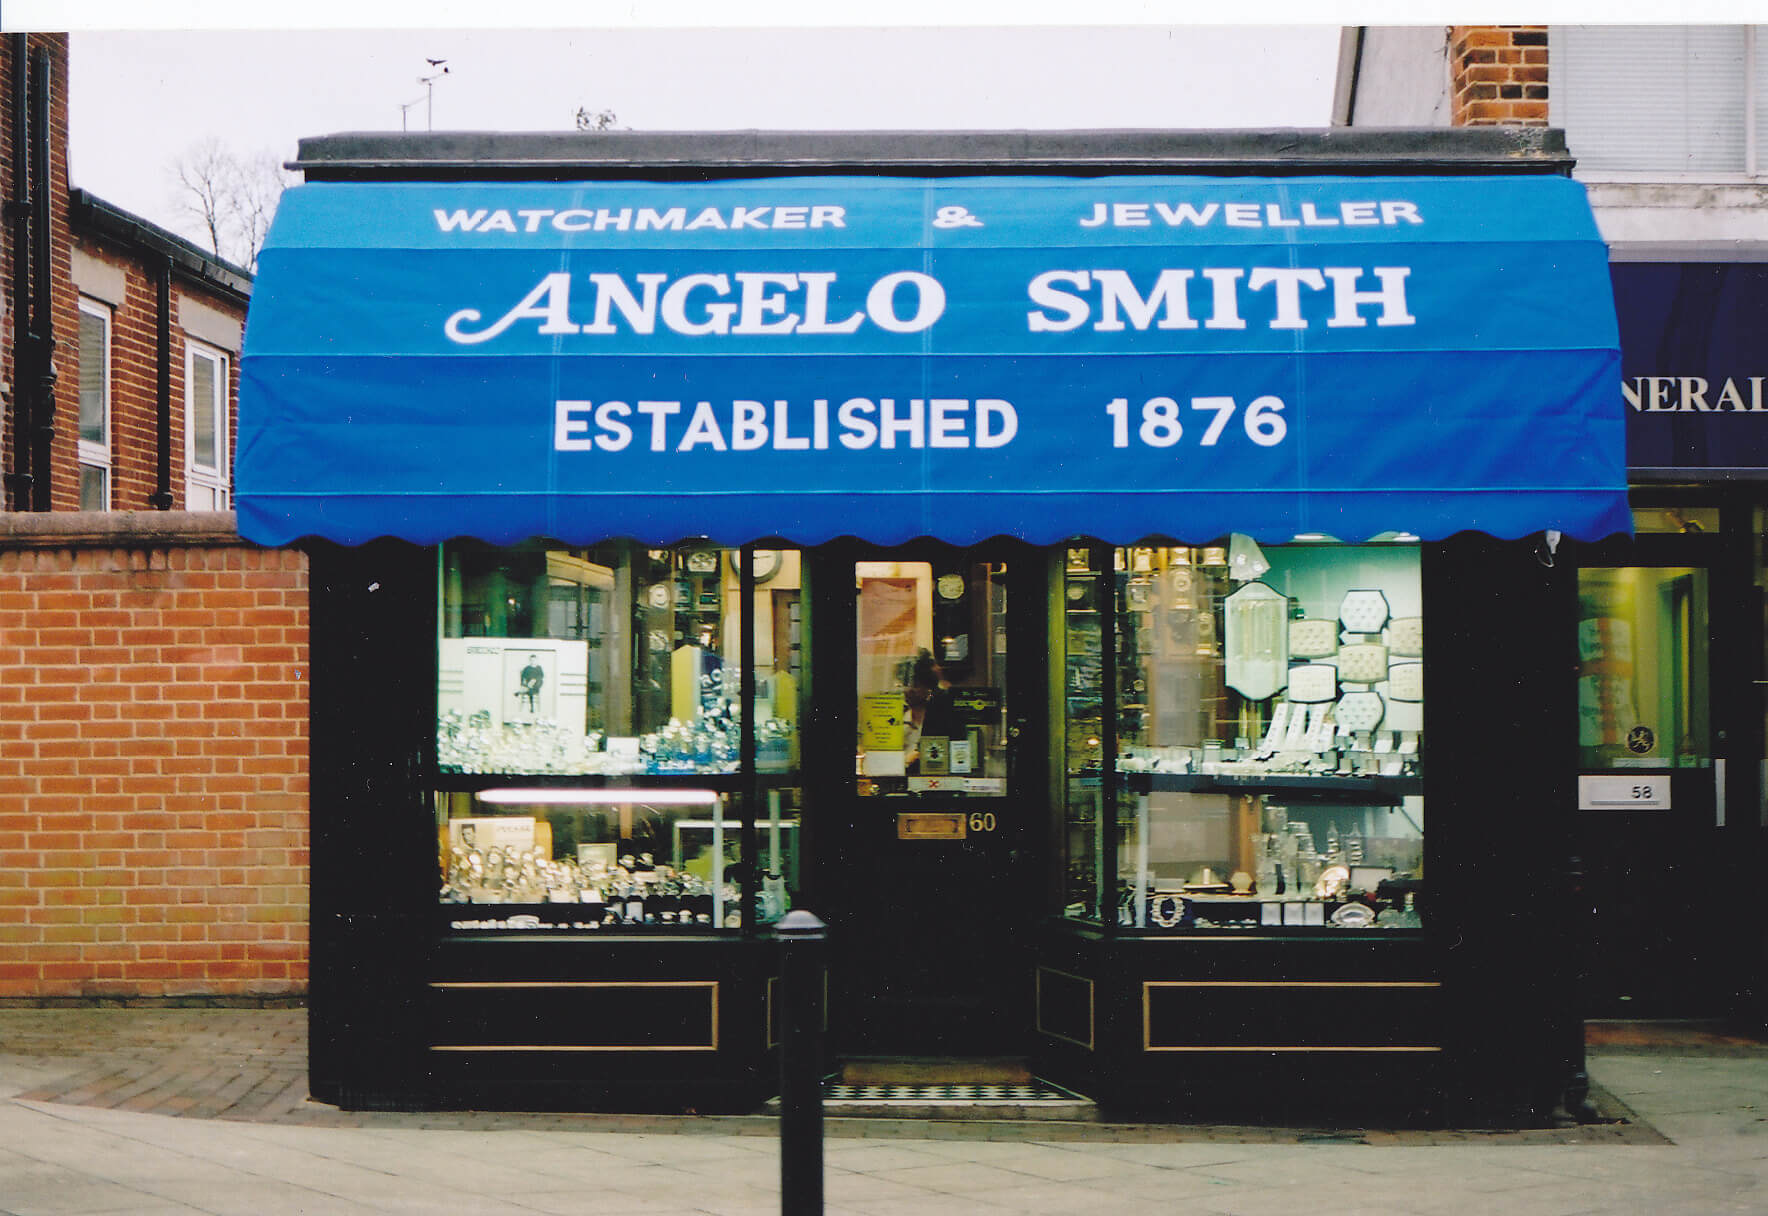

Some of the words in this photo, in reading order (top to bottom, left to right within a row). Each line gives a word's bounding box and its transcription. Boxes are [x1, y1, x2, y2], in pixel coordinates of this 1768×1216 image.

[434, 205, 846, 234] WATCHMAKER
[932, 205, 984, 229] &
[1078, 201, 1424, 229] JEWELLER
[444, 271, 946, 344] ANGELO
[1027, 266, 1416, 333] SMITH
[554, 398, 1018, 453] ESTABLISHED
[1105, 395, 1288, 449] 1876
[1631, 785, 1653, 799] 58
[969, 812, 997, 832] 60
